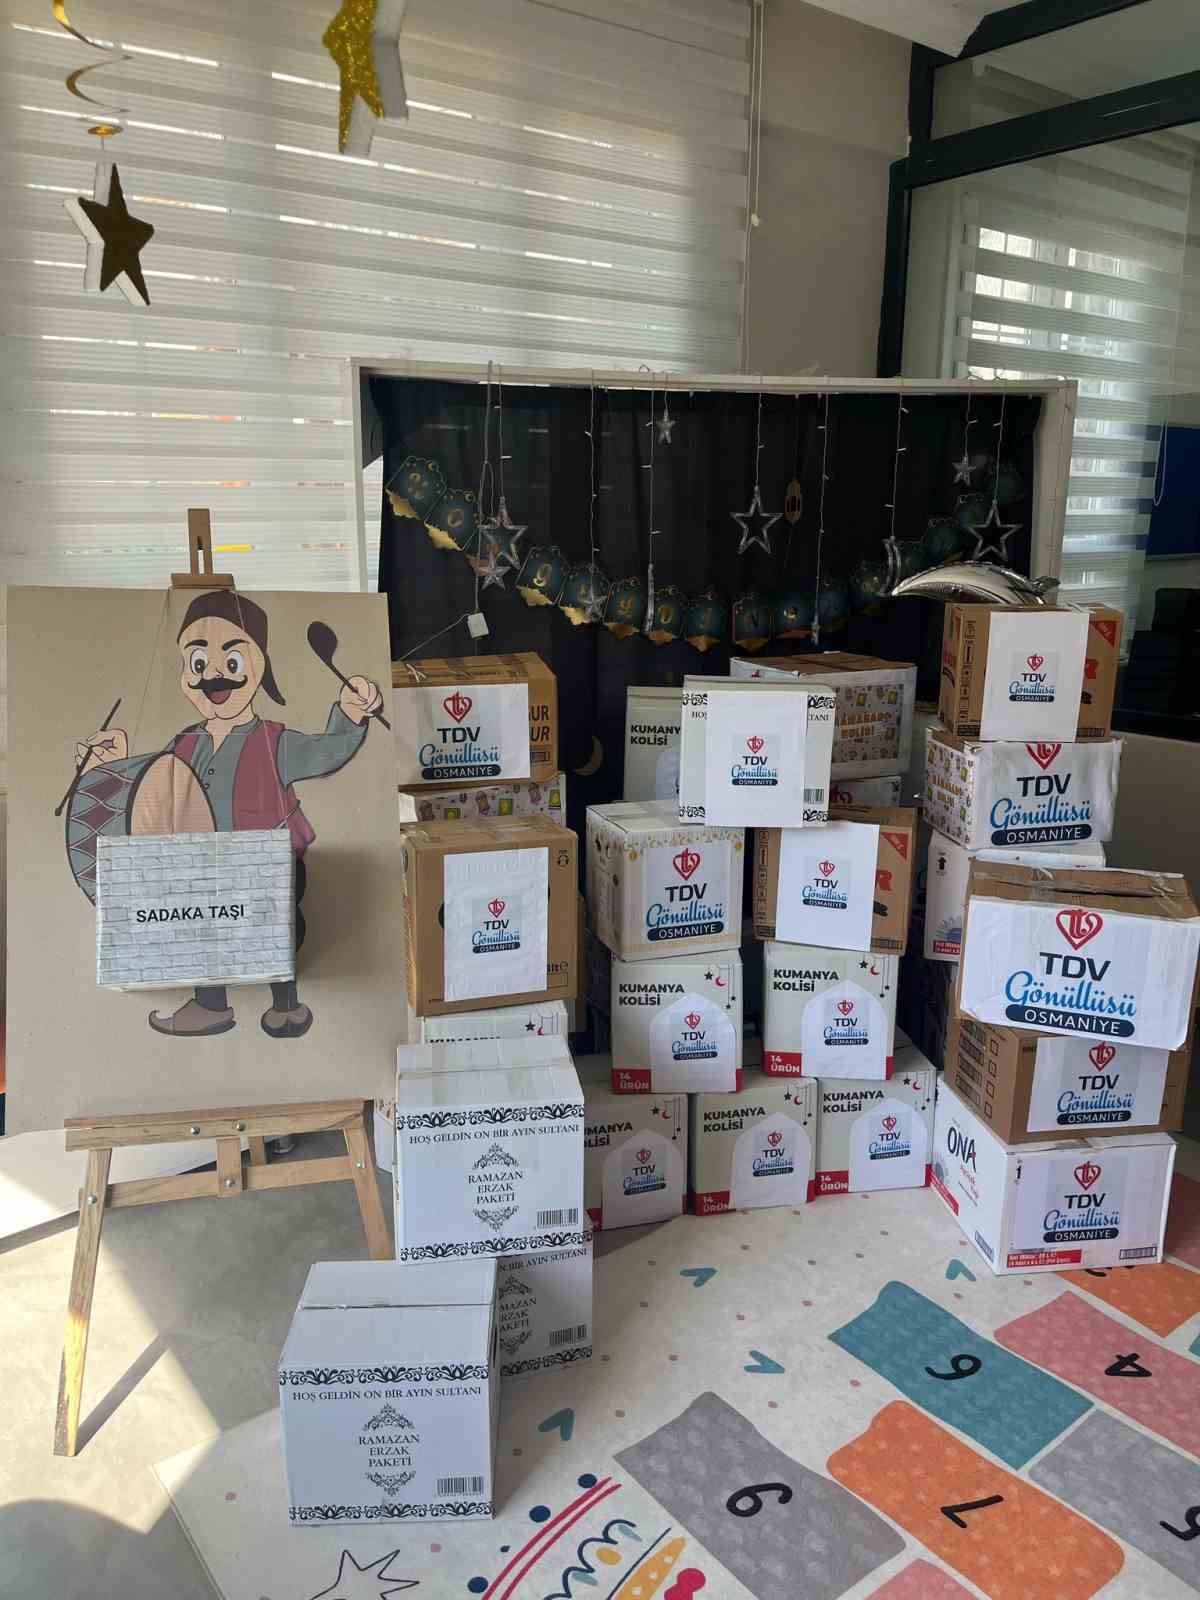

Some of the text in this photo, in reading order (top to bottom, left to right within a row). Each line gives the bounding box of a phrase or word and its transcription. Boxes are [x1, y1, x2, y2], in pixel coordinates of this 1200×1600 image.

[1021, 672, 1048, 683] TDV
[1008, 681, 1055, 695] Gönüllüsü
[437, 727, 481, 744] TDV
[630, 725, 681, 735] KUMANY
[630, 735, 668, 746] KOLİSİ
[419, 742, 500, 768] Gönüllüsü
[742, 755, 768, 766] TDV
[731, 764, 778, 779] Gönüllüsü
[1016, 773, 1072, 797] TDV
[990, 796, 1092, 829] Gönüllüsü
[1006, 826, 1082, 843] OSMANİYE
[814, 878, 839, 889] TDV
[665, 883, 707, 903] TDV
[136, 904, 244, 923] SADAKA TAŞI
[646, 900, 724, 929] Gönüllüsü
[483, 919, 510, 930] TDV
[659, 923, 716, 939] OSMANİYE
[1039, 951, 1112, 981] TDV
[773, 969, 839, 981] KUMANYA
[619, 984, 685, 993] KUMANYA
[773, 980, 815, 992] KOLİSİ
[619, 994, 661, 1006] KOLİSİ
[1004, 970, 1137, 1017] Gönüllüsü
[833, 1017, 858, 1027] TDV
[1024, 1008, 1121, 1035] OSMANİYE
[681, 1031, 707, 1041] TDV
[1078, 1074, 1120, 1090] TDV
[823, 1089, 884, 1101] KUMANYA
[1056, 1089, 1134, 1113] Gönüllüsü
[823, 1100, 862, 1113] KOLİSİ
[704, 1106, 765, 1121] KUMANYA
[1067, 1112, 1124, 1123] OSMANİYE
[584, 1122, 633, 1136] MANYA
[704, 1119, 743, 1133] KOLİSİ
[409, 1135, 431, 1144] HOŞ
[434, 1132, 472, 1143] GELDİN
[474, 1131, 490, 1140] ON
[512, 1127, 536, 1136] AYIN
[538, 1124, 579, 1135] SULTANI
[879, 1131, 901, 1141] TDV
[584, 1135, 610, 1148] LİSİ
[763, 1148, 785, 1158] TDV
[948, 1126, 977, 1172] ONA
[633, 1164, 656, 1176] TDV
[468, 1171, 523, 1184] RAMAZAN
[478, 1183, 513, 1194] ERZAK
[476, 1192, 515, 1205] PAKETİ
[1064, 1193, 1106, 1209] TDV
[1043, 1208, 1120, 1232] Gönüllüsü
[1054, 1229, 1112, 1241] OSMANİYE
[500, 1311, 528, 1322] RZAK
[500, 1319, 529, 1332] AKETİ
[1104, 1353, 1152, 1377] 4
[293, 1387, 481, 1403] HOŞ GELDİN ON BİR AYIN SULTANI
[359, 1434, 420, 1446] RAMAZAN
[369, 1446, 411, 1456] ERZAK
[368, 1456, 412, 1467] PAKETİ
[940, 1494, 1004, 1529] 7
